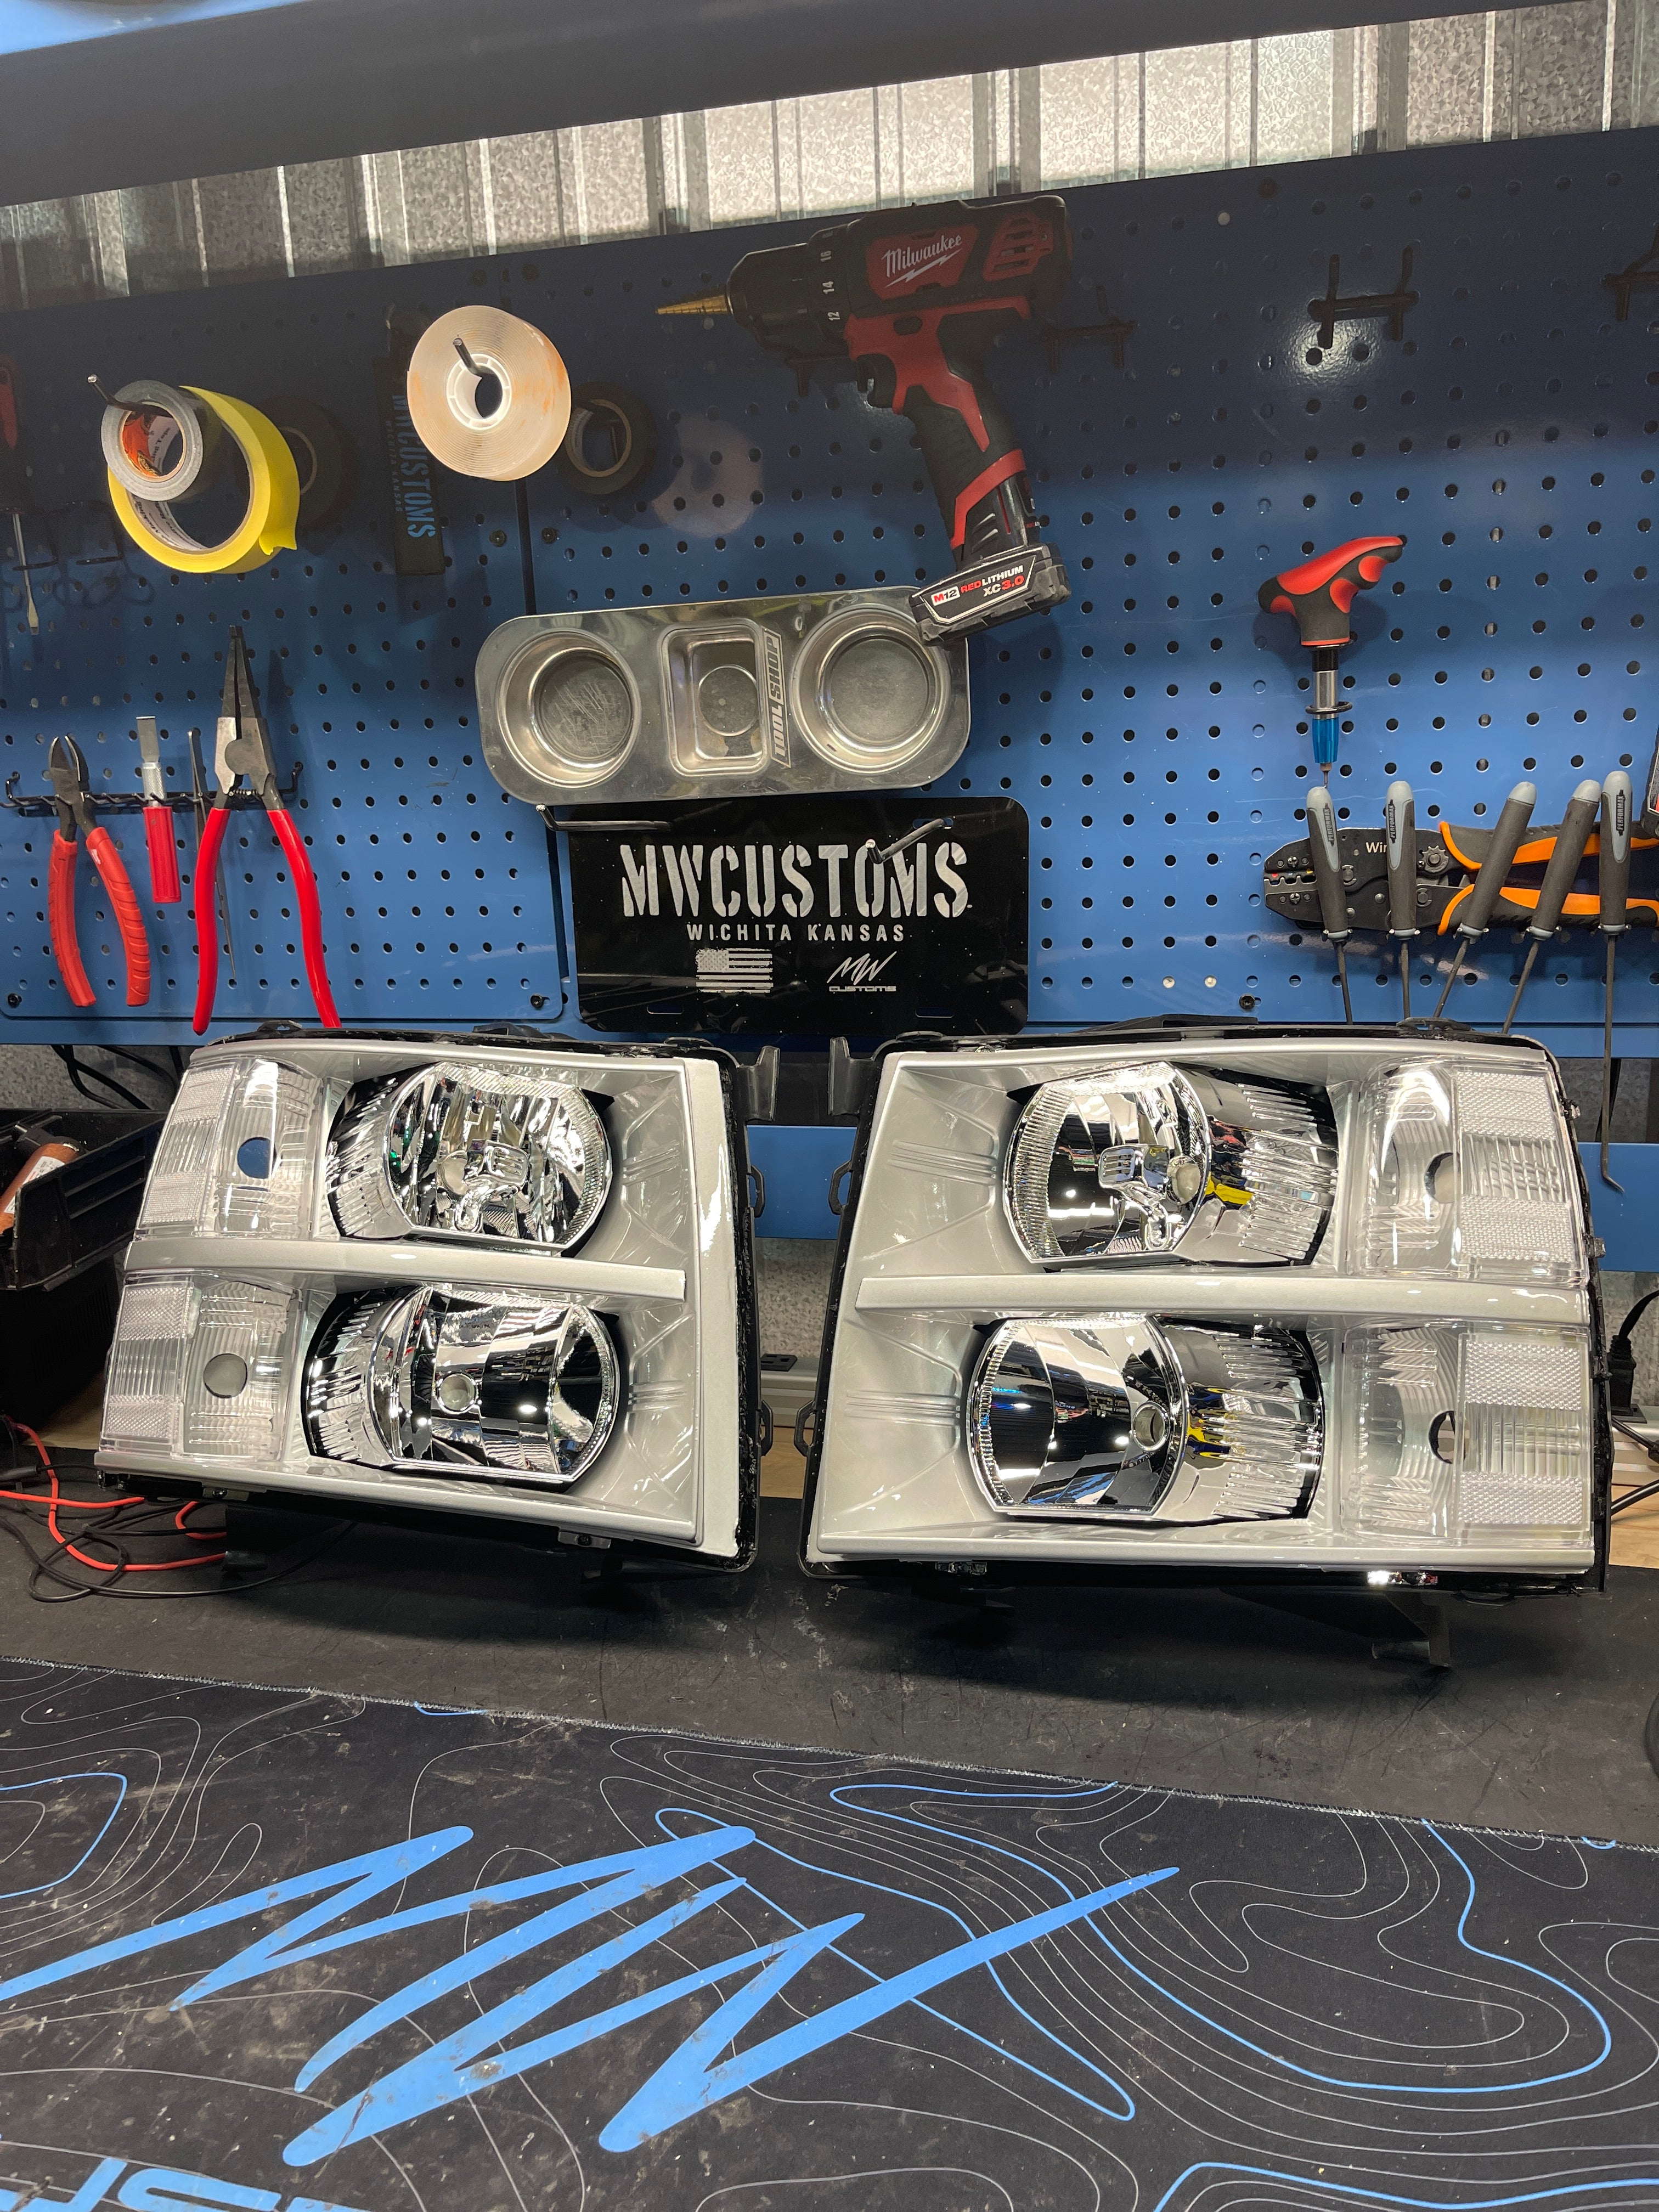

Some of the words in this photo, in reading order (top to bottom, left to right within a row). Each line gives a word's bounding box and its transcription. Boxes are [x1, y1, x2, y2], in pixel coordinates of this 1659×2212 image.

[820, 250, 832, 262] 16
[881, 235, 963, 278] Milwaukee
[822, 281, 834, 295] 14
[827, 311, 840, 321] 12
[392, 470, 403, 513] KANSAS
[933, 589, 958, 603] M12
[766, 636, 781, 700] SHOP
[771, 705, 786, 757] TOOL
[620, 842, 969, 918] MWCUSTOMS
[686, 924, 792, 941] WICHITA
[808, 924, 904, 941] KANSAS
